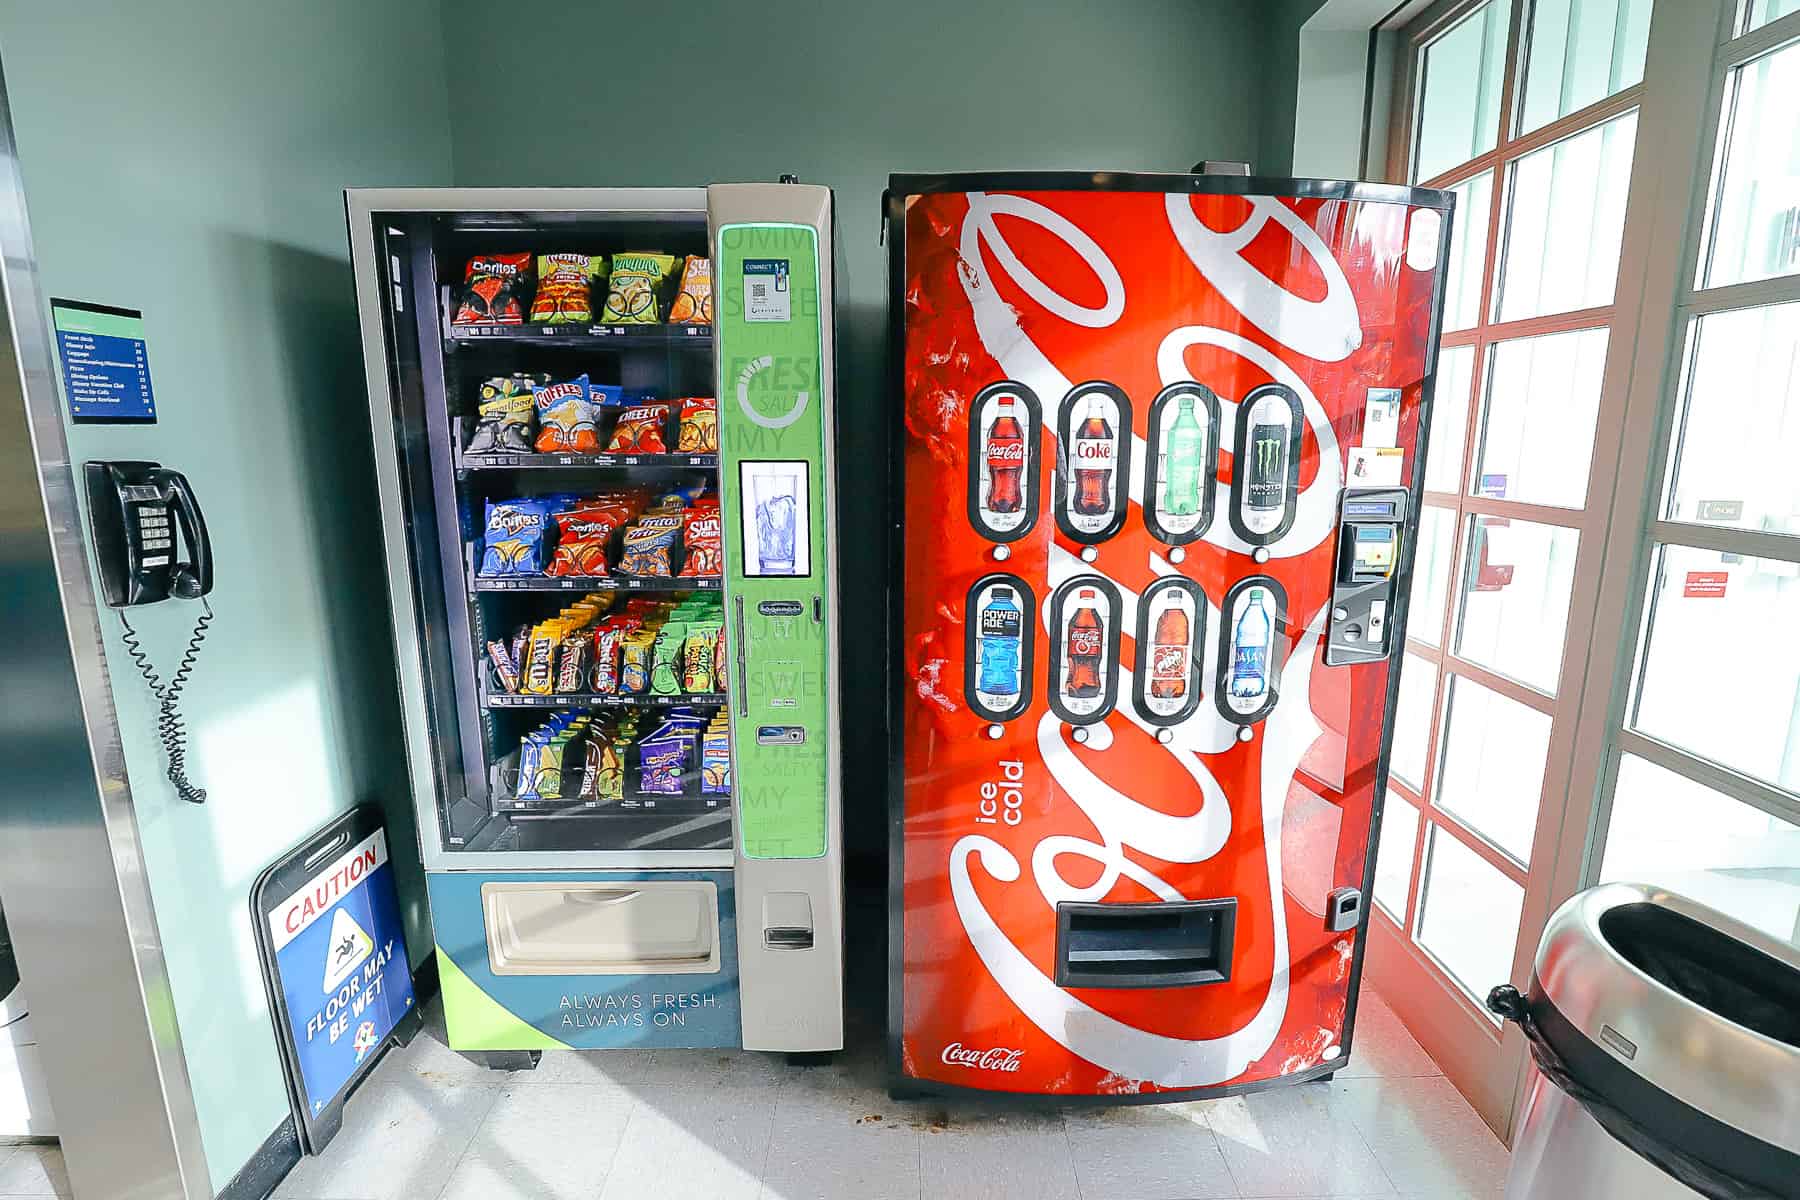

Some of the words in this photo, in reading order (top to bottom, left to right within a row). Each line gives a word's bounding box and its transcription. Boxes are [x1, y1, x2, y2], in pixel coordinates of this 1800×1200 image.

[472, 260, 518, 274] Doritos
[535, 383, 583, 409] RUFFLES
[987, 442, 1023, 460] Coca-Cola
[1077, 441, 1111, 459] Coke
[489, 513, 540, 529] Doritos
[567, 521, 612, 534] Doritos
[983, 610, 1019, 621] POWER
[598, 632, 612, 692] Skittles
[975, 781, 998, 824] ice
[998, 760, 1024, 826] cold
[285, 844, 378, 934] CAUTION
[305, 973, 361, 1043] FLOOR
[363, 940, 395, 979] MAY
[559, 993, 642, 1009] ALWAYS
[652, 993, 722, 1010] FRESH,
[327, 1013, 350, 1045] BE
[352, 972, 385, 1018] WET
[561, 1012, 644, 1027] ALWAYS
[652, 1012, 686, 1027] ON
[941, 1042, 1025, 1072] Coca-Cola
